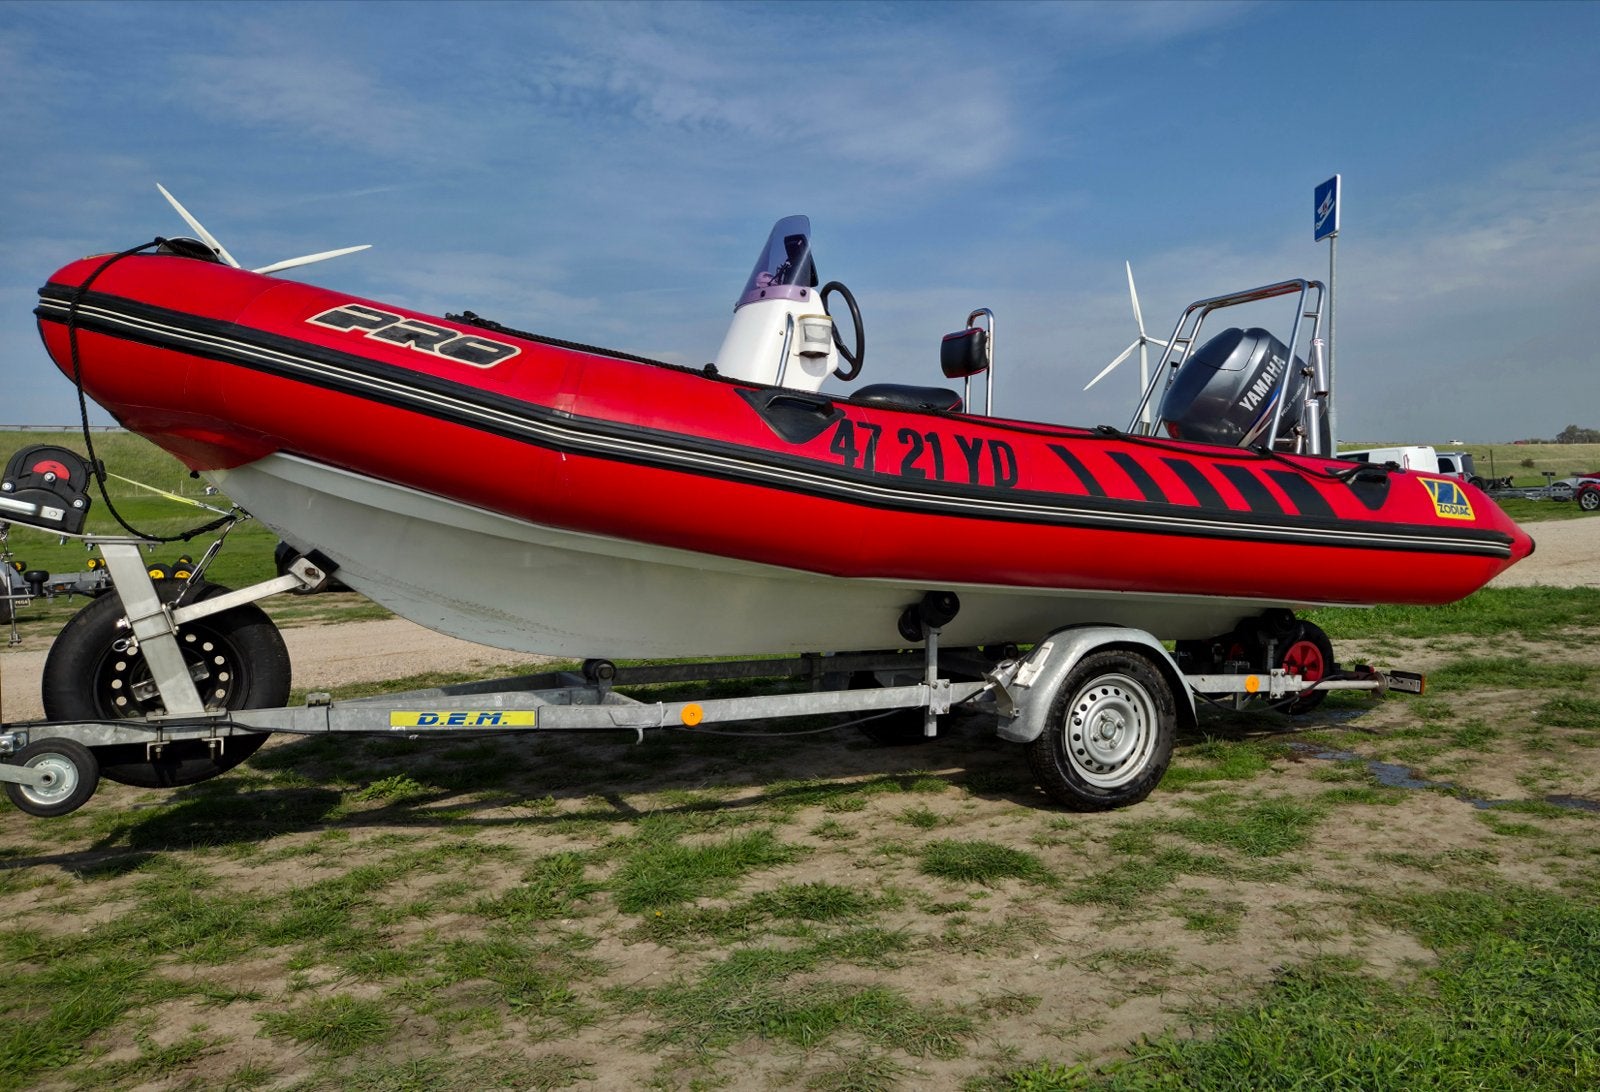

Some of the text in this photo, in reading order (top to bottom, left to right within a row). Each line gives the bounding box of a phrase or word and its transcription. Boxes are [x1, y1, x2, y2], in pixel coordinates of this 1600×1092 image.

[305, 303, 522, 369] PRO
[1238, 354, 1286, 411] YAMAHA
[830, 418, 1018, 488] 47 21 YD
[1437, 503, 1471, 516] ZODIAC
[416, 712, 508, 726] D.E.M.
